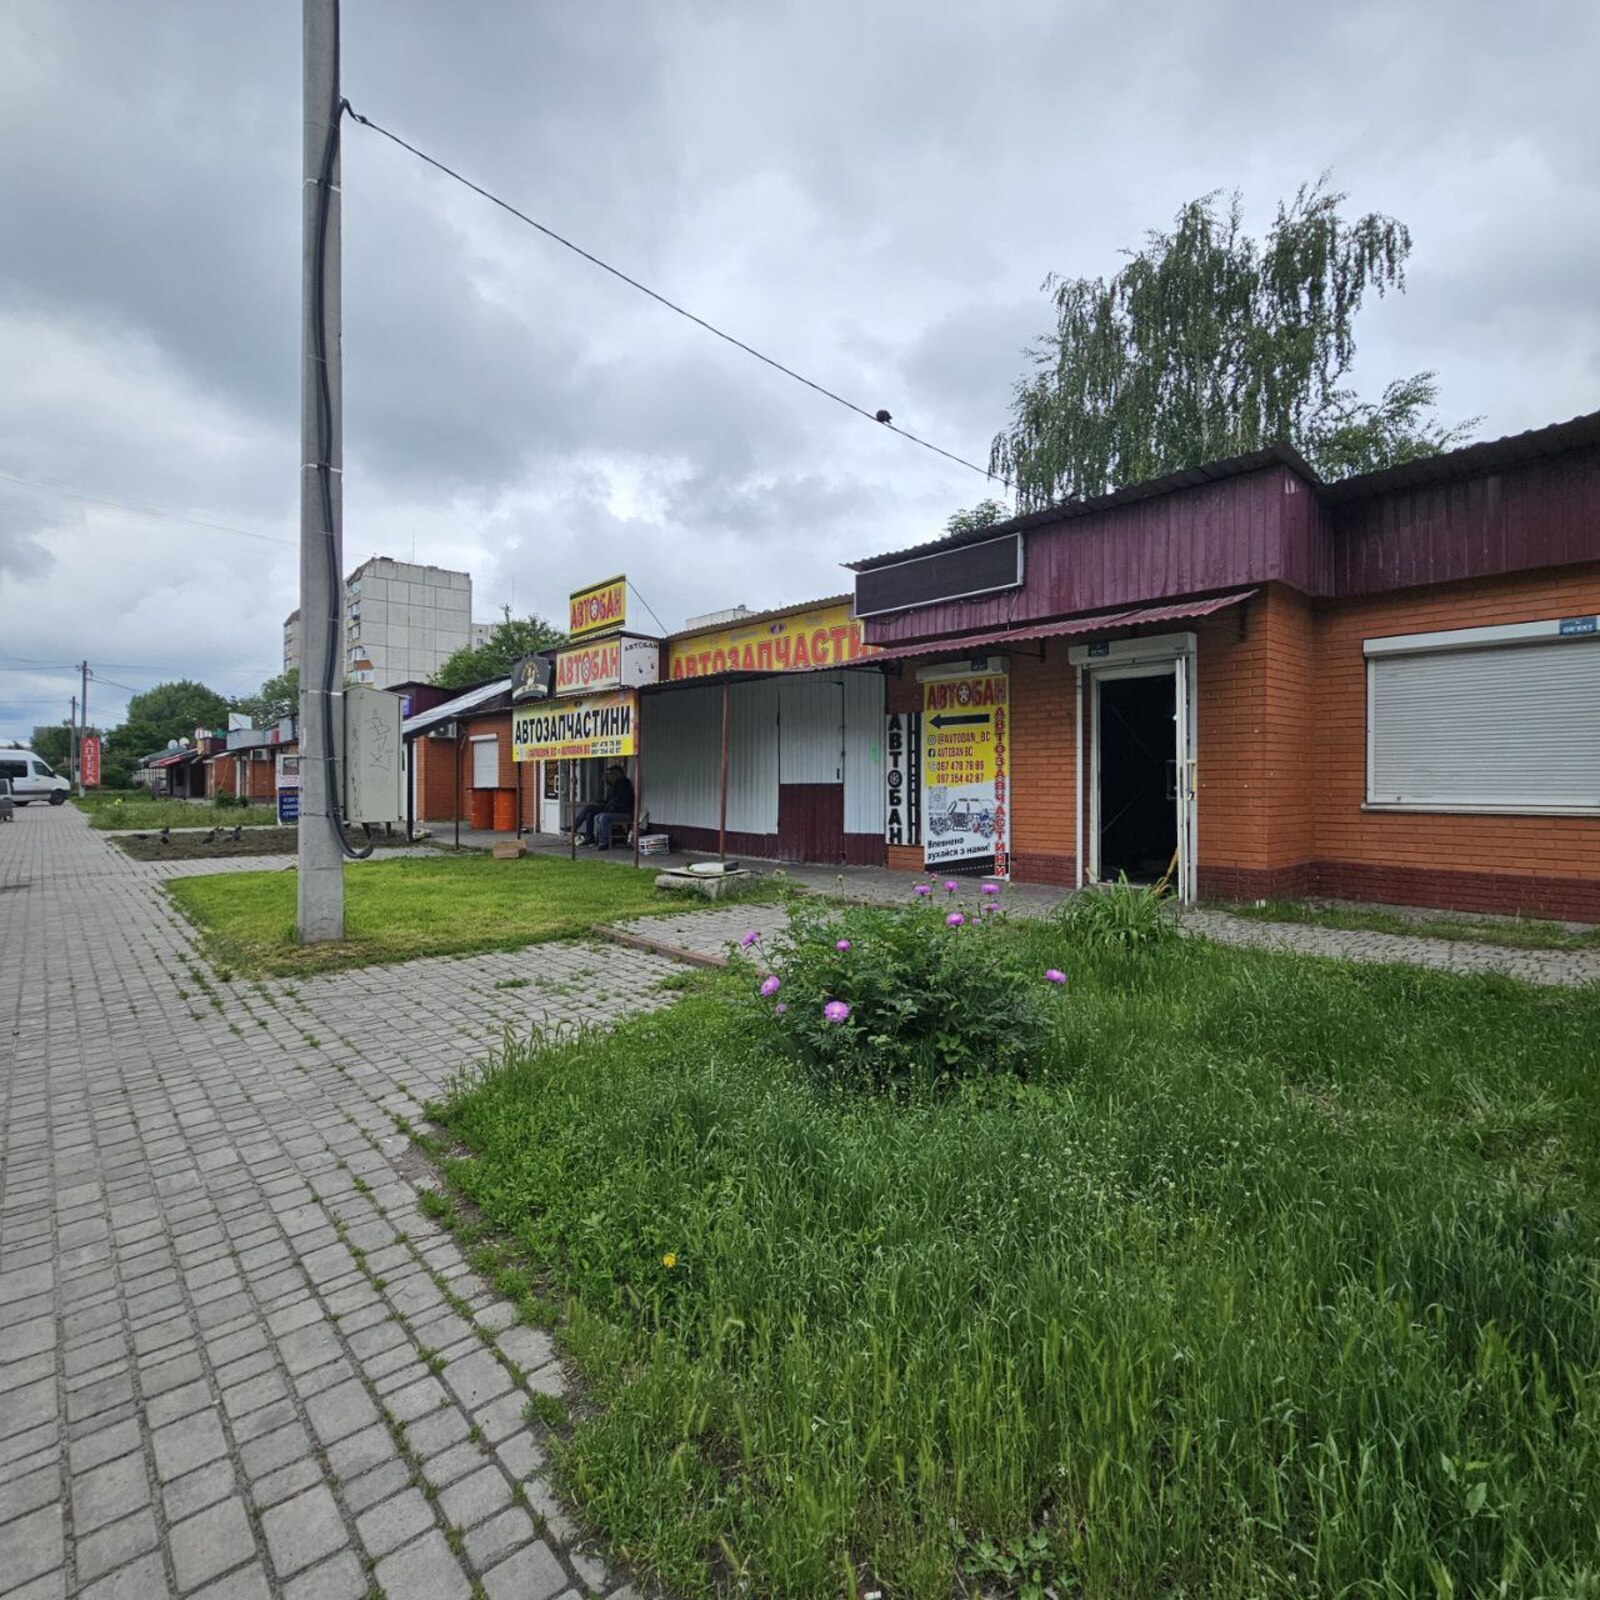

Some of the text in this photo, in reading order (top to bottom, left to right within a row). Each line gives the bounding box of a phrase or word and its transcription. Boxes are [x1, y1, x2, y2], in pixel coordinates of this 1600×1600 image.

[571, 588, 622, 630] АВТОБАН
[558, 646, 618, 686] АВТОБАН
[625, 643, 659, 651] АВТОБАН
[673, 624, 883, 680] АВТОЗАПЧАСТИ
[927, 678, 1006, 710] АВТОБАН
[515, 705, 631, 744] АВТОЗАПЧАСТИНИ
[85, 739, 96, 785] АПТЕКА
[888, 713, 903, 844] АВТОБАН
